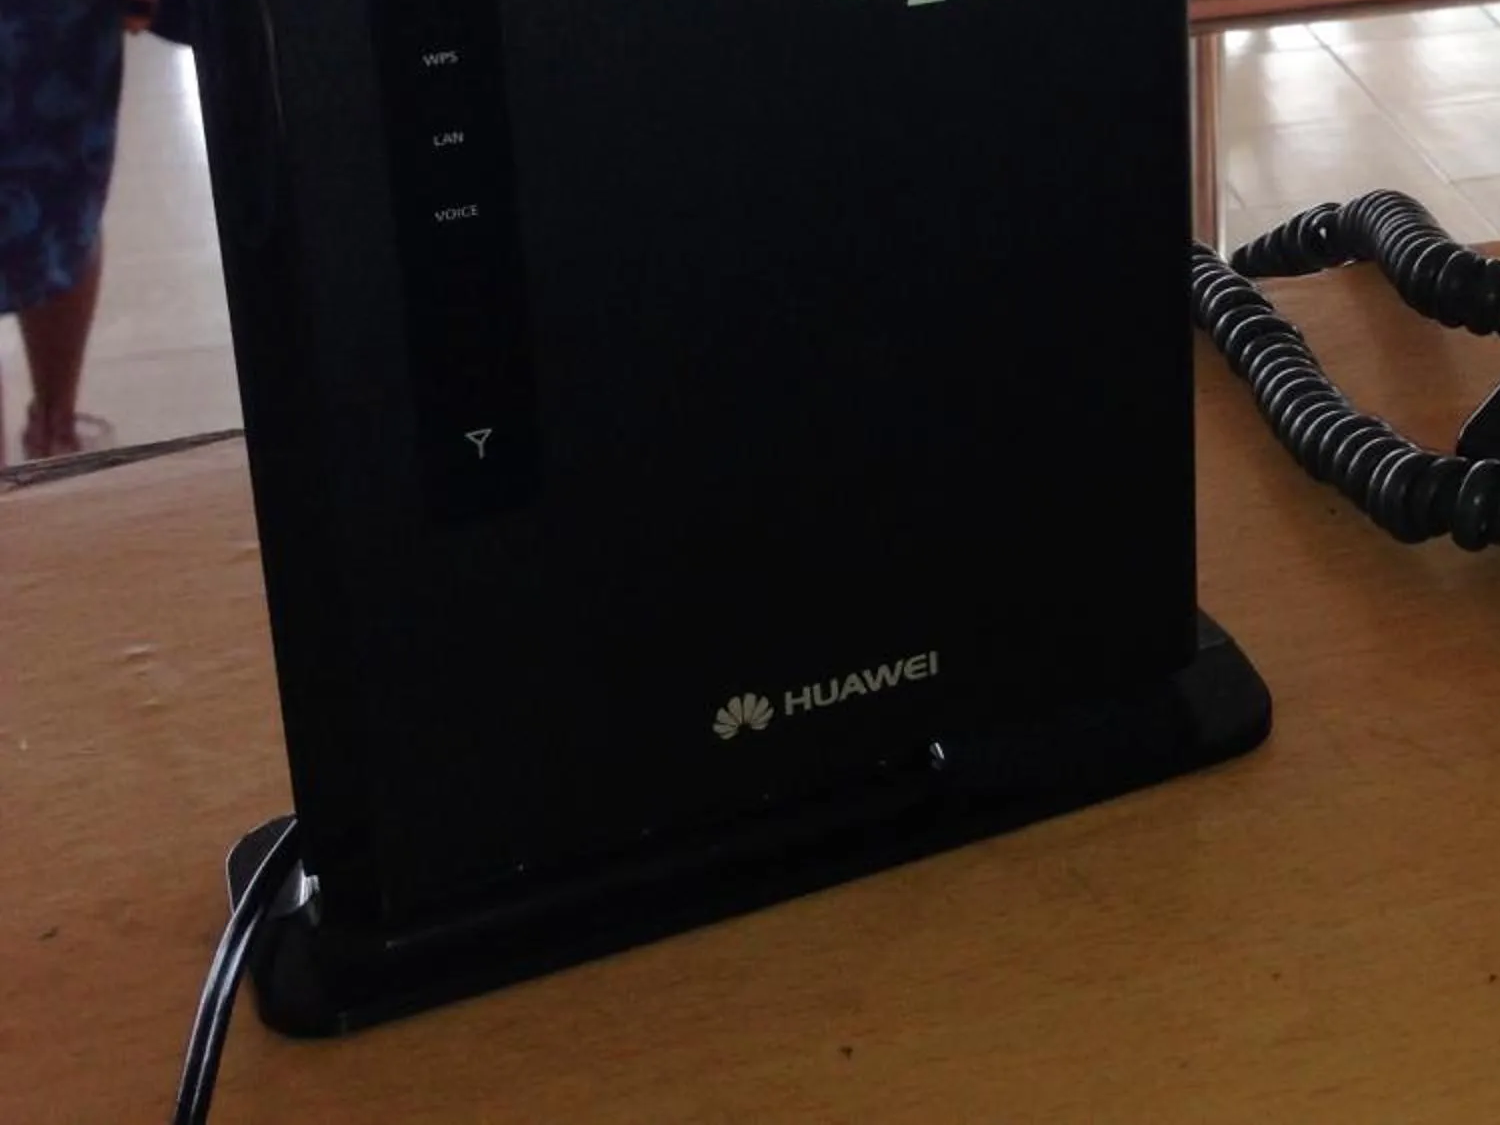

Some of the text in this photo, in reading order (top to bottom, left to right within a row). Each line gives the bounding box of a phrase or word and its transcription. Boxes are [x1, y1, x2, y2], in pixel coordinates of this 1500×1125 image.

[421, 50, 459, 68] WPS
[433, 130, 465, 147] LAN
[434, 204, 479, 223] VOICE
[783, 650, 940, 716] HUAWEI
